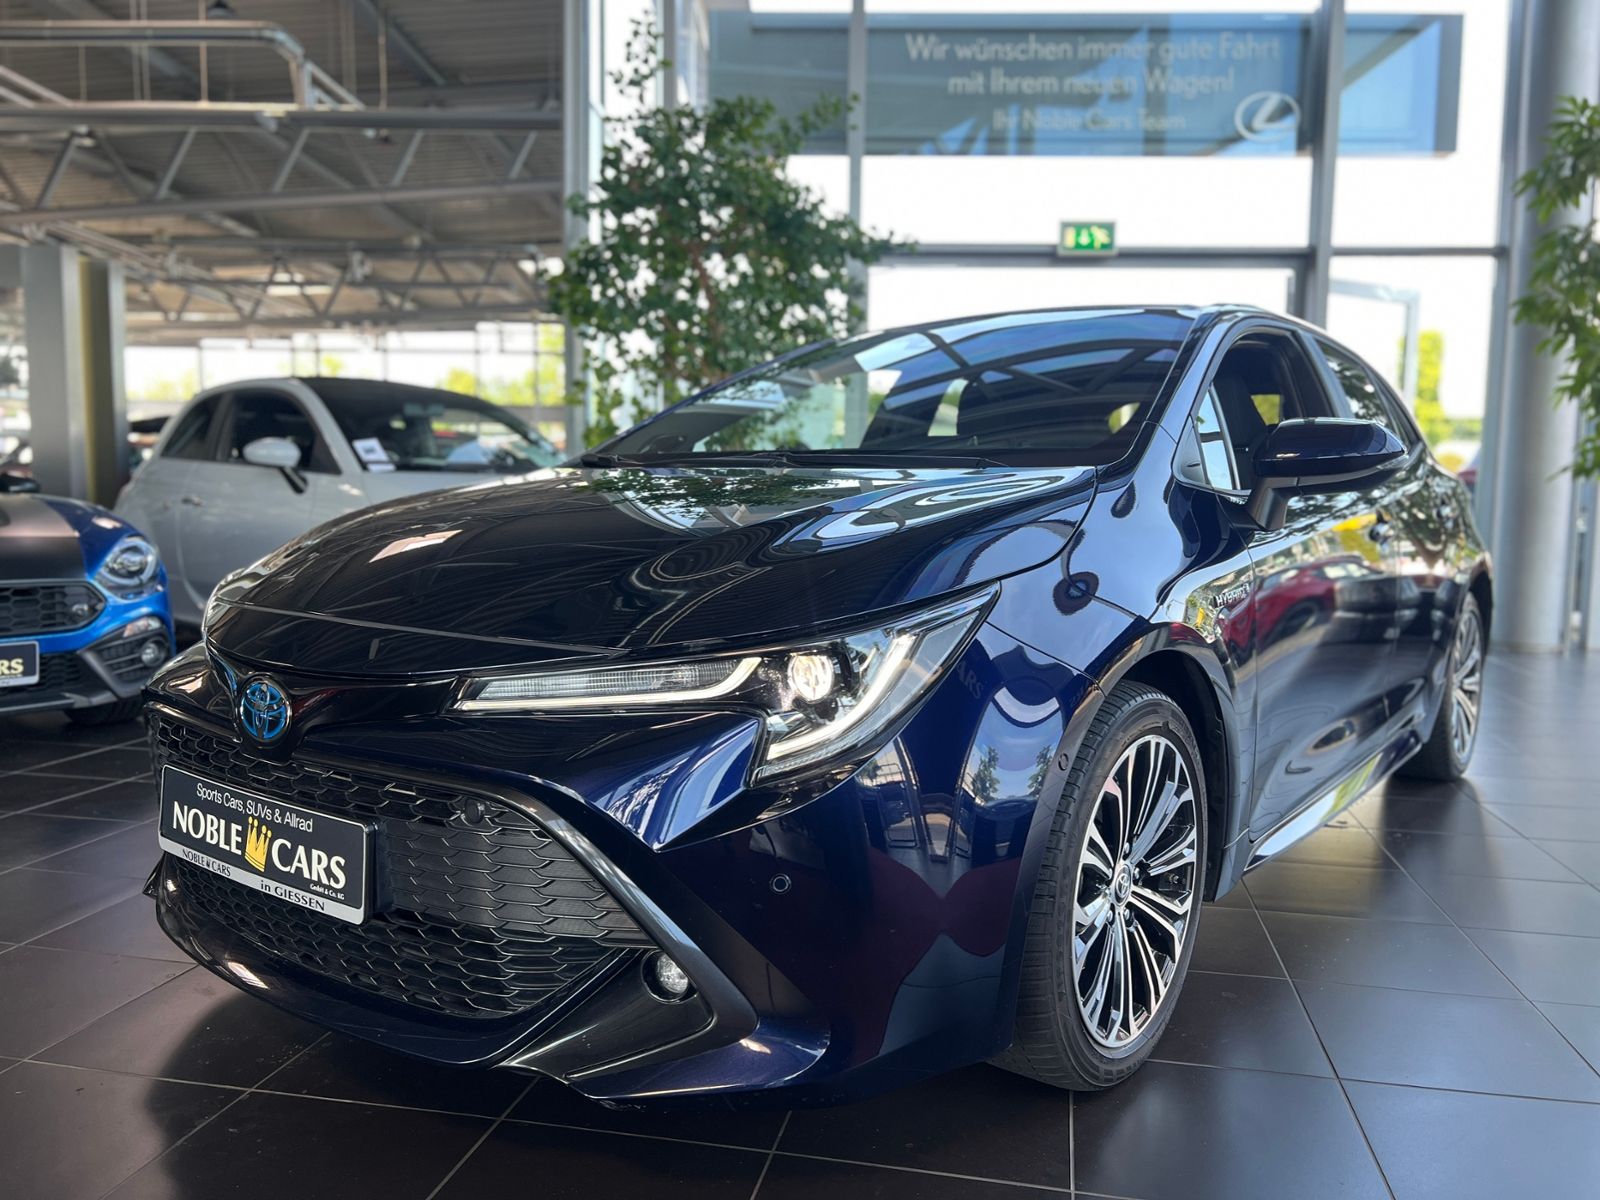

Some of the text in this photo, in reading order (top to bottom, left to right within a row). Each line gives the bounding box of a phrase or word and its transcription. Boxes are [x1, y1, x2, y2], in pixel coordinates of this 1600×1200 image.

[905, 32, 1281, 66] Wir wünschen immer gute Fahrt
[948, 66, 1235, 99] mit Ihrem neuen Wagen!
[993, 108, 1186, 131] Ihr Noble Cars Team
[196, 782, 313, 833] Sports Cars, SUVs & Allrad
[172, 800, 346, 890] NOBLE CARS
[182, 848, 231, 877] NOBLE CARS
[260, 879, 325, 911] in GIESSEN
